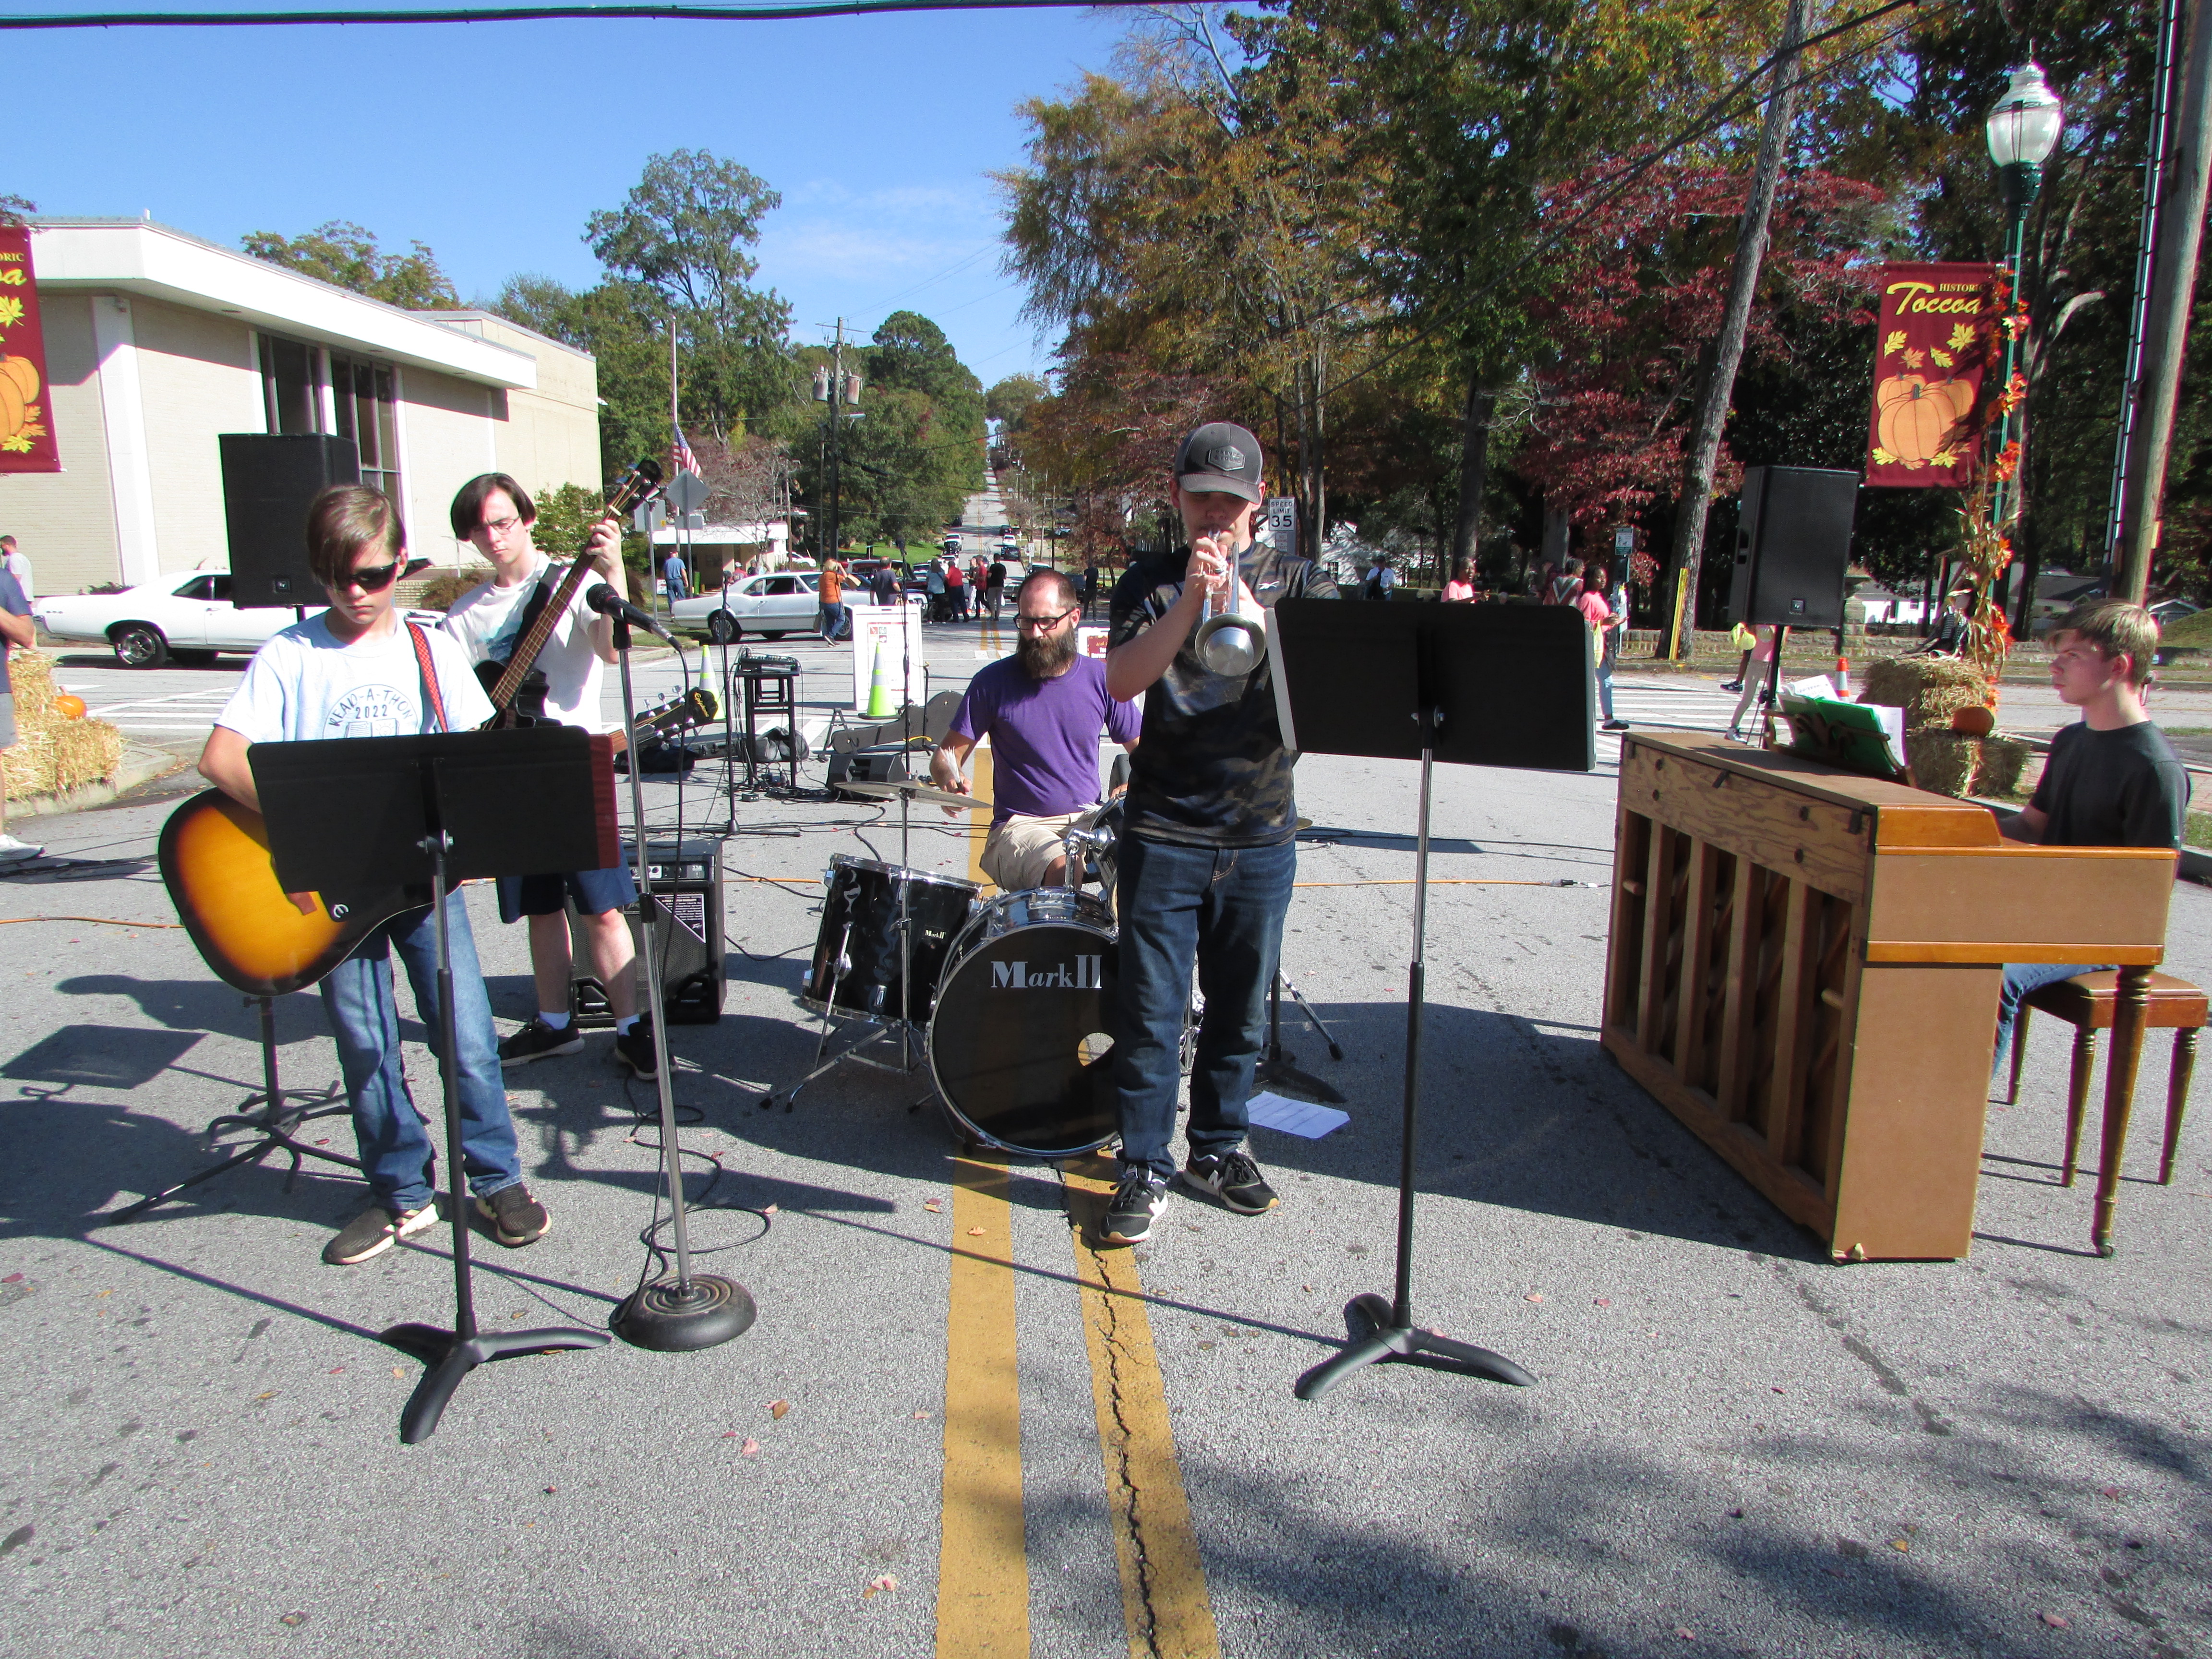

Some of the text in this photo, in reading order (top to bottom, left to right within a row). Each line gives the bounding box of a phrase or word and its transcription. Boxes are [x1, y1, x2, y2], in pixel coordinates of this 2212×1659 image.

[1939, 283, 1984, 292] HISTORIC
[1886, 281, 1984, 315] Toccoa
[1271, 515, 1292, 528] 35
[329, 688, 413, 727] READ-A-THON
[355, 705, 388, 719] 2022
